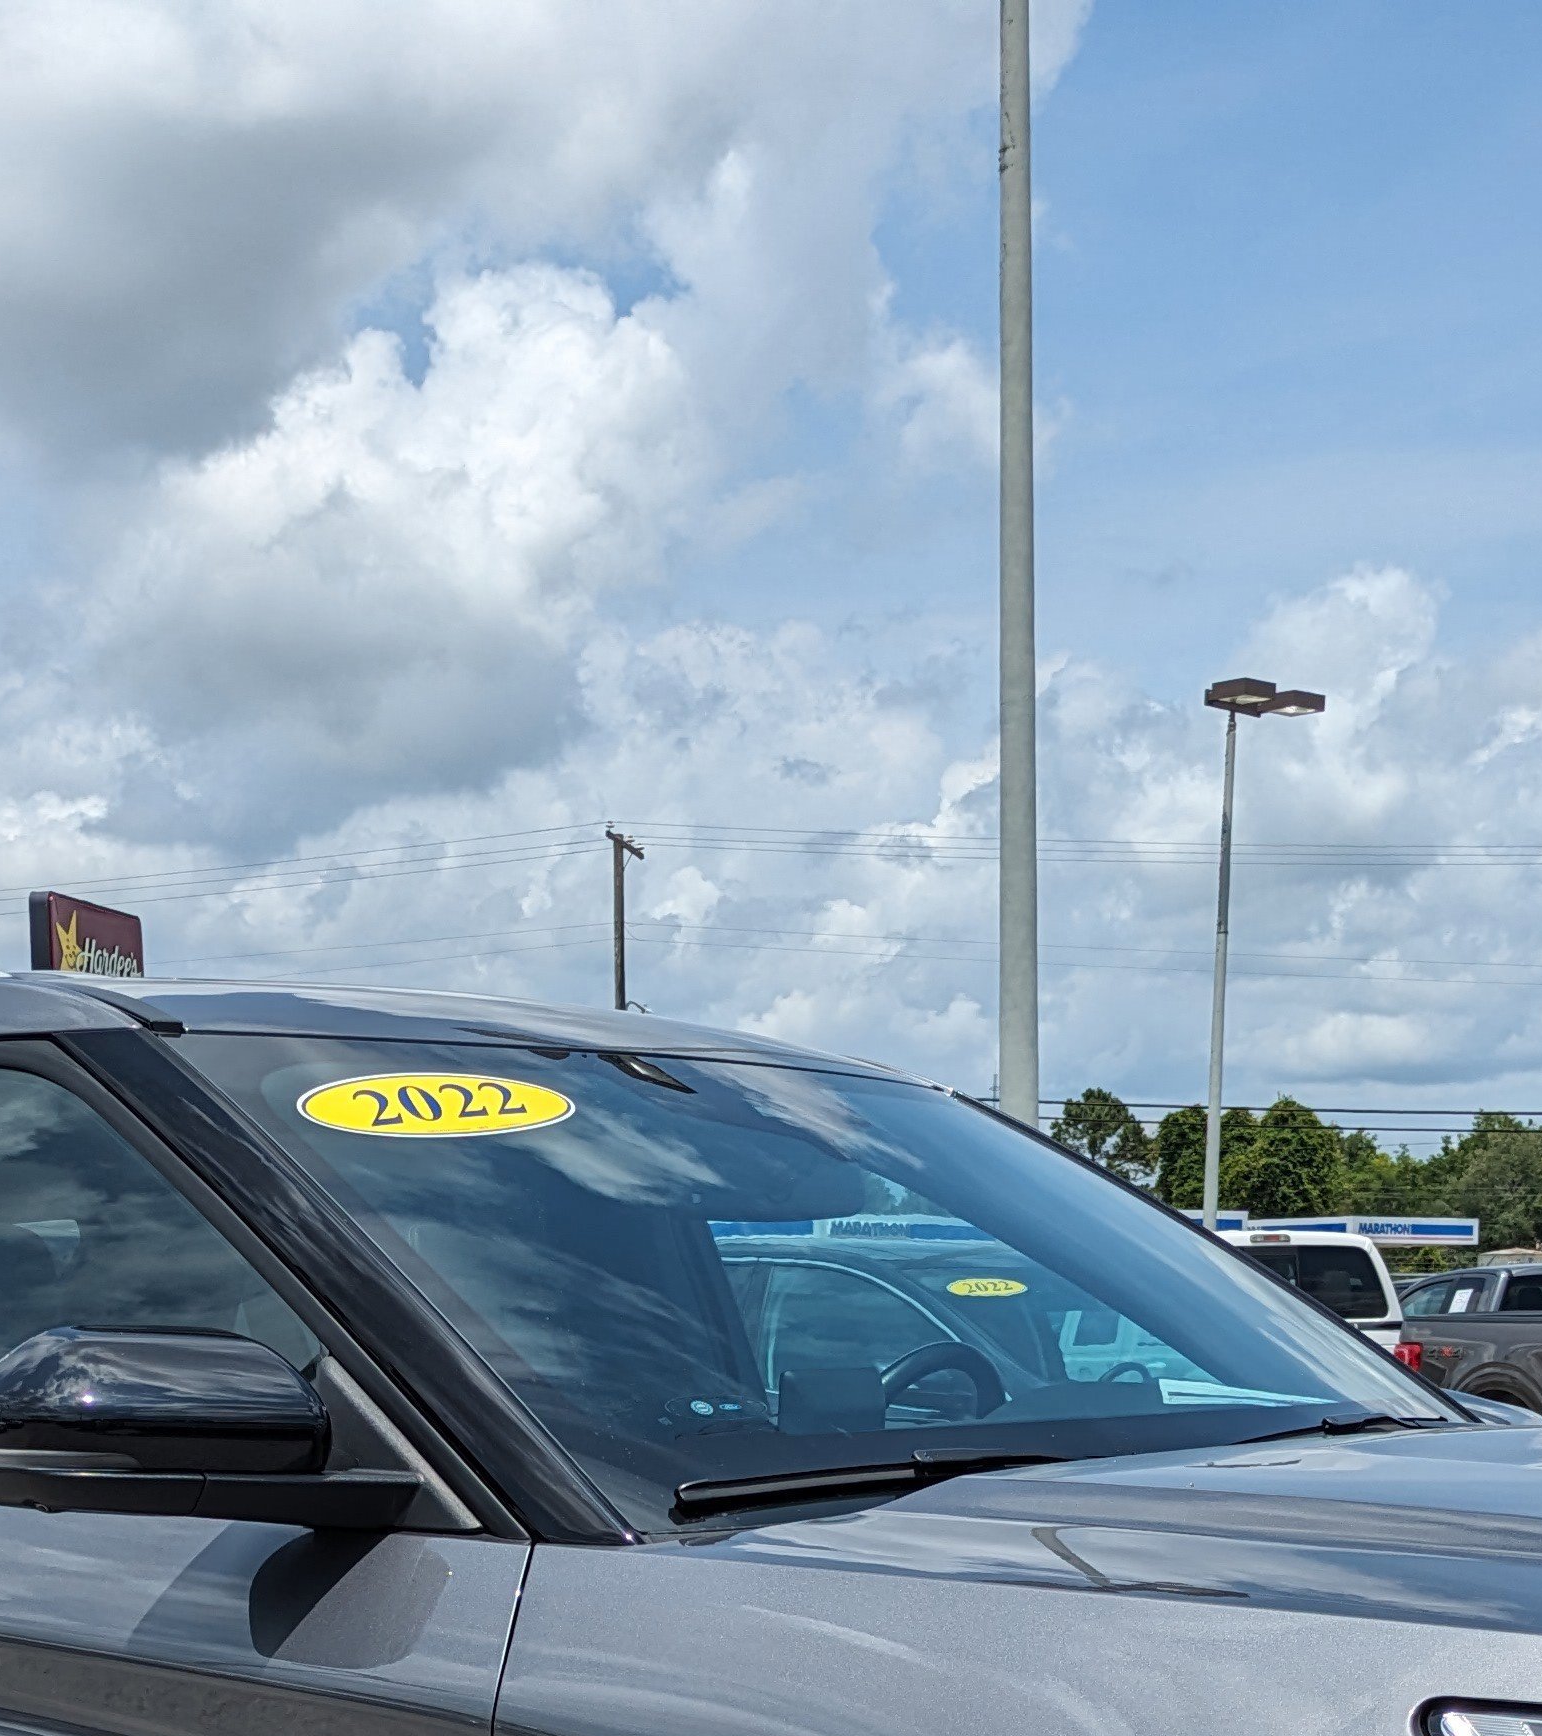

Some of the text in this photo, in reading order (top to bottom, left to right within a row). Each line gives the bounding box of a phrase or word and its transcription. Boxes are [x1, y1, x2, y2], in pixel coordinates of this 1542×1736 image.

[76, 938, 143, 977] Hardee's
[352, 1082, 528, 1127] 2022
[830, 1220, 910, 1237] MARATHON
[1358, 1222, 1411, 1235] MARATHON
[962, 1281, 1013, 1293] 2022
